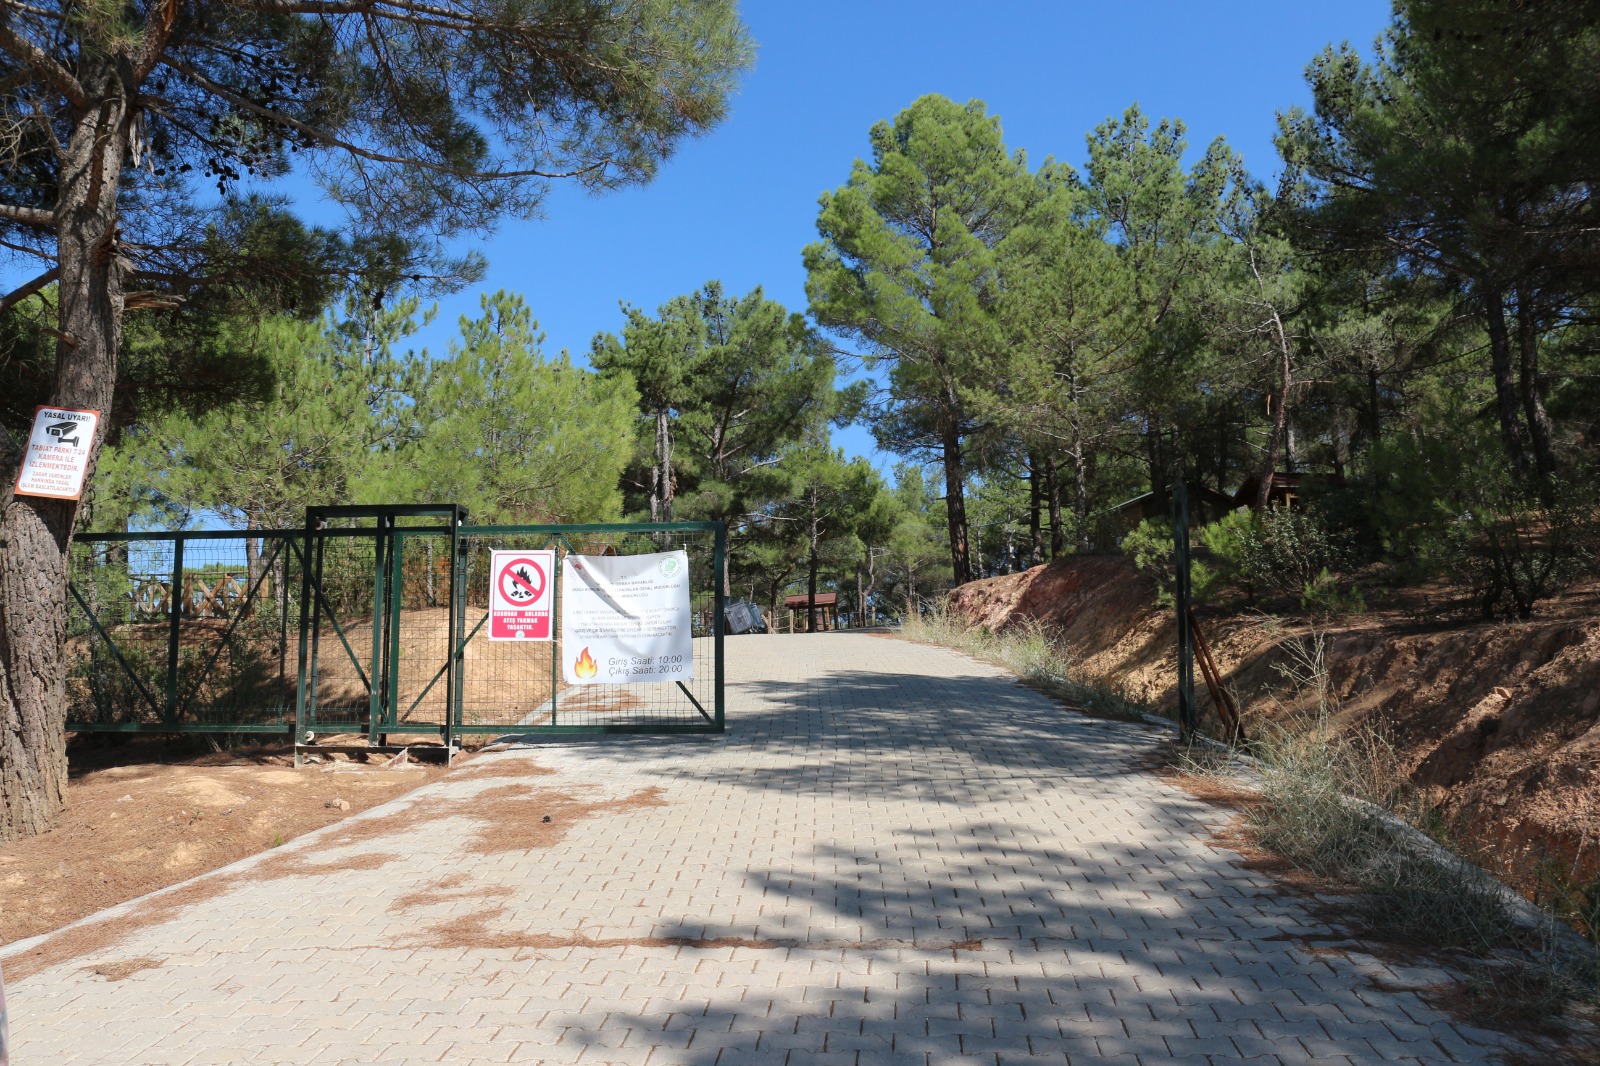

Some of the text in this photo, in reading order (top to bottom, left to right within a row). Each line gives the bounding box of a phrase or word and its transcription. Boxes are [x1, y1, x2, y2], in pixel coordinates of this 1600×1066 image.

[44, 412, 91, 422] YASAL UYARI!
[608, 655, 683, 667] Giriş Saati: 10:00
[608, 665, 682, 677] Çıkış Saati: 20:00
